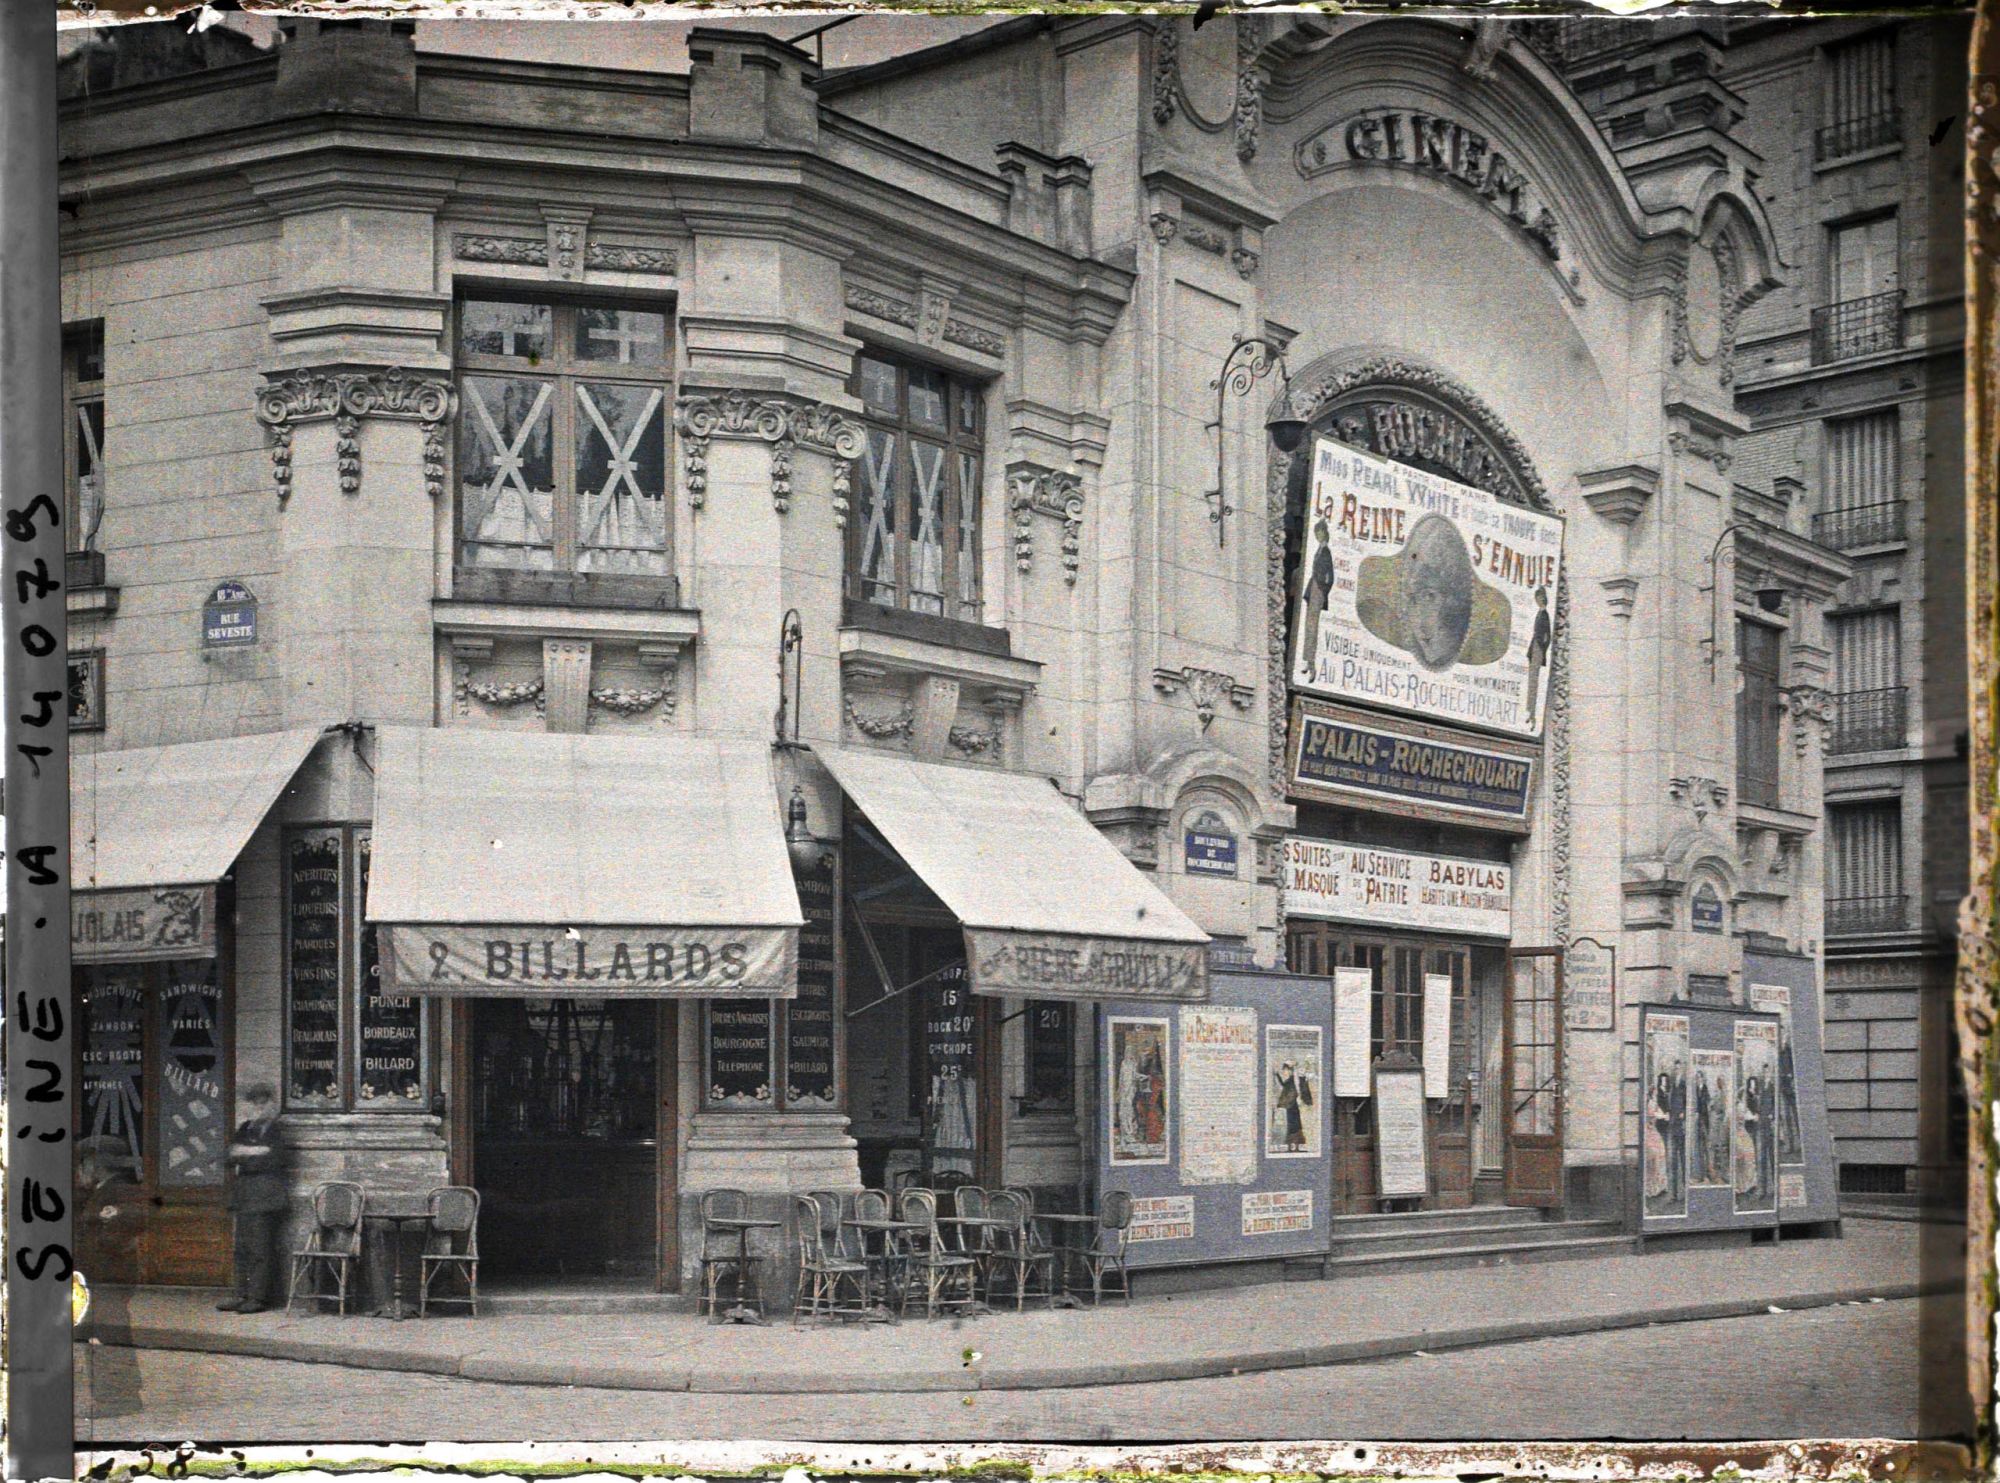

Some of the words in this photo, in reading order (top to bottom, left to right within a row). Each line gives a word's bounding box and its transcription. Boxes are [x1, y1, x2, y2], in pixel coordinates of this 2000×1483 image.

[1345, 113, 1560, 261] CINEMA
[1353, 457, 1401, 499] PEARL
[1407, 479, 1460, 519] WHITE
[1337, 490, 1407, 546] REINE
[1473, 533, 1556, 590] S'ENNUIE
[220, 612, 240, 625] RUE
[207, 625, 253, 640] SEVESTE
[1325, 629, 1360, 658] VISIBLE
[1473, 676, 1522, 697] MONTMARTRE
[1293, 841, 1331, 867] SUITES
[1351, 853, 1365, 874] AU
[1368, 852, 1411, 880] SERVICE
[1429, 859, 1505, 891] BABYLAS
[1365, 877, 1409, 905] PATRIE
[485, 939, 748, 982] BILLARDS
[369, 995, 410, 1009] PUNCH
[928, 1021, 952, 1034] BOCK
[1039, 1009, 1060, 1028] 20
[364, 1026, 416, 1040] BORDEAUX
[713, 1036, 767, 1049] BOURGOGNE
[943, 1043, 973, 1055] CHOPE
[365, 1057, 415, 1071] BILLARD
[164, 1062, 219, 1099] BILLARD
